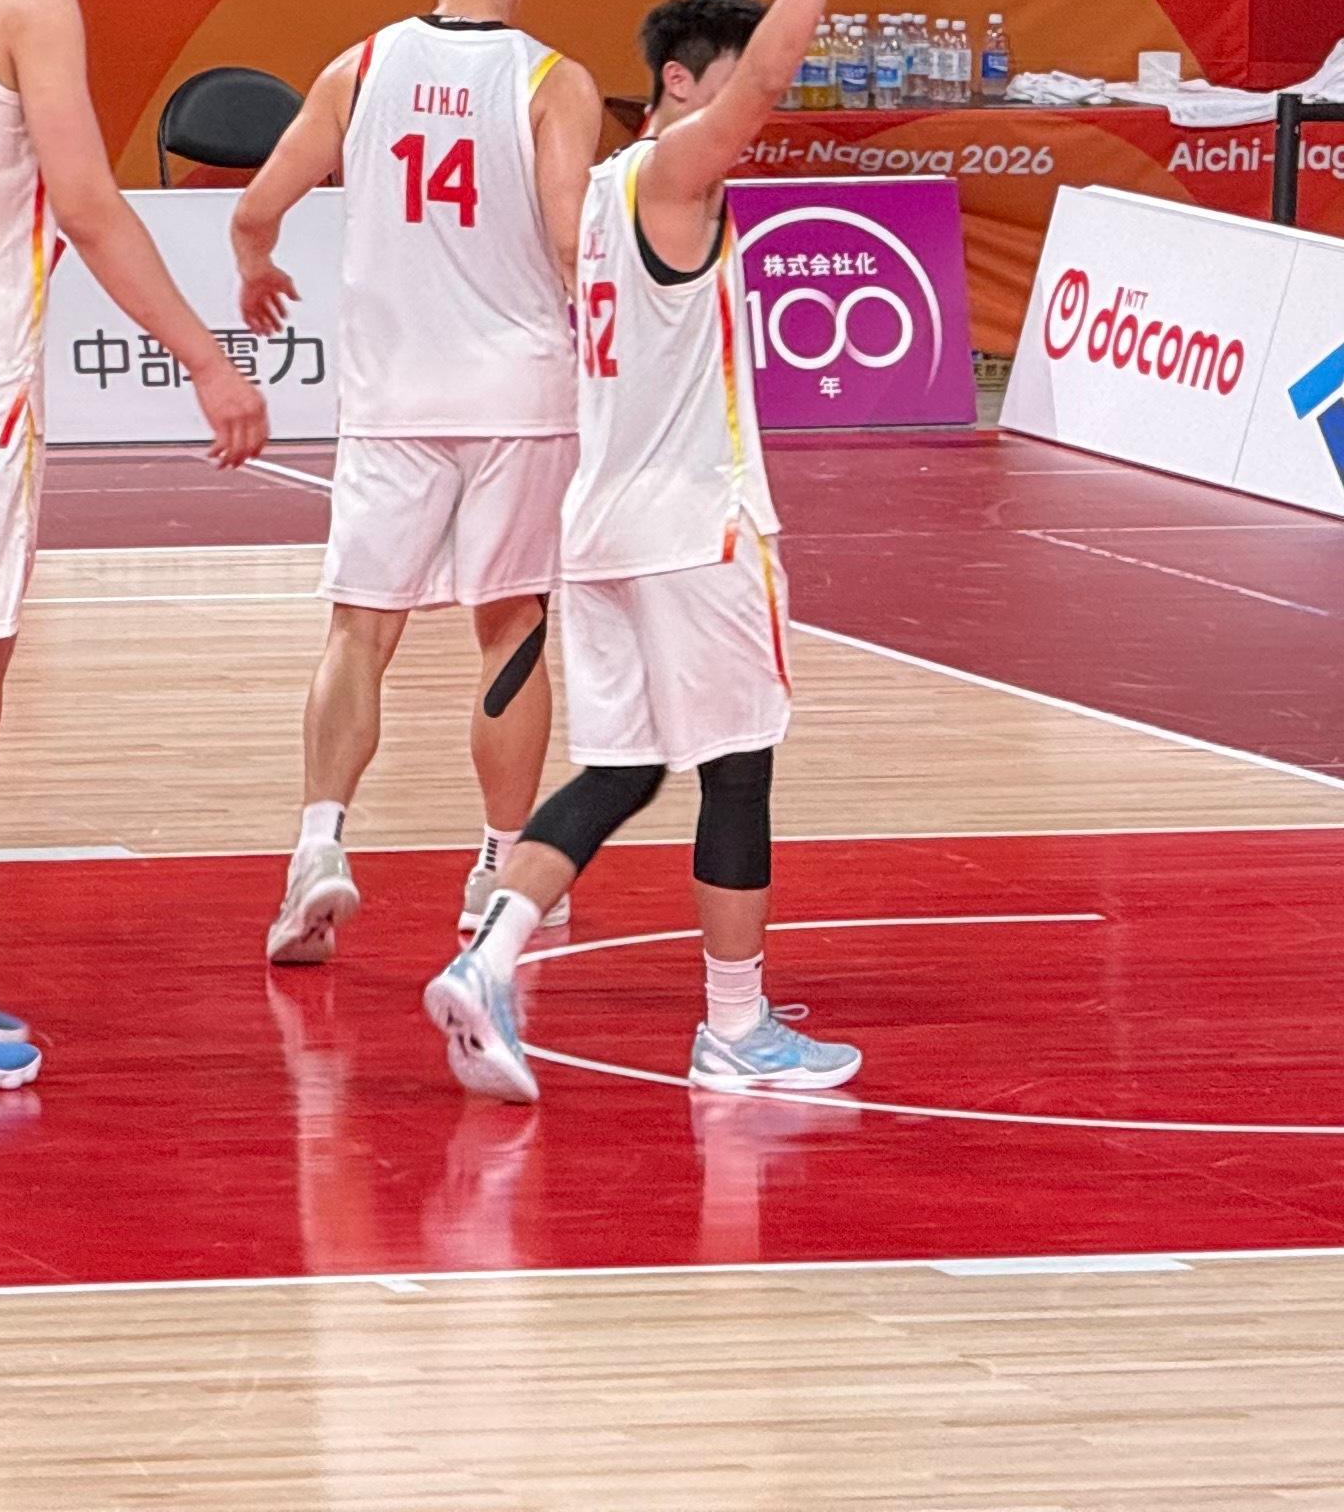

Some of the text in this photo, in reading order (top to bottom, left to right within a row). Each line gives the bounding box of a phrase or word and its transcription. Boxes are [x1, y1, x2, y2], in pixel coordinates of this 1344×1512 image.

[413, 83, 435, 114] LI
[737, 139, 1055, 175] chi-Nagoya 2026
[390, 133, 478, 228] 14
[763, 251, 879, 278] 株式会社化
[1124, 288, 1150, 310] NTT
[745, 286, 913, 370] 100
[1087, 286, 1245, 396] docomo
[819, 375, 843, 399] 年
